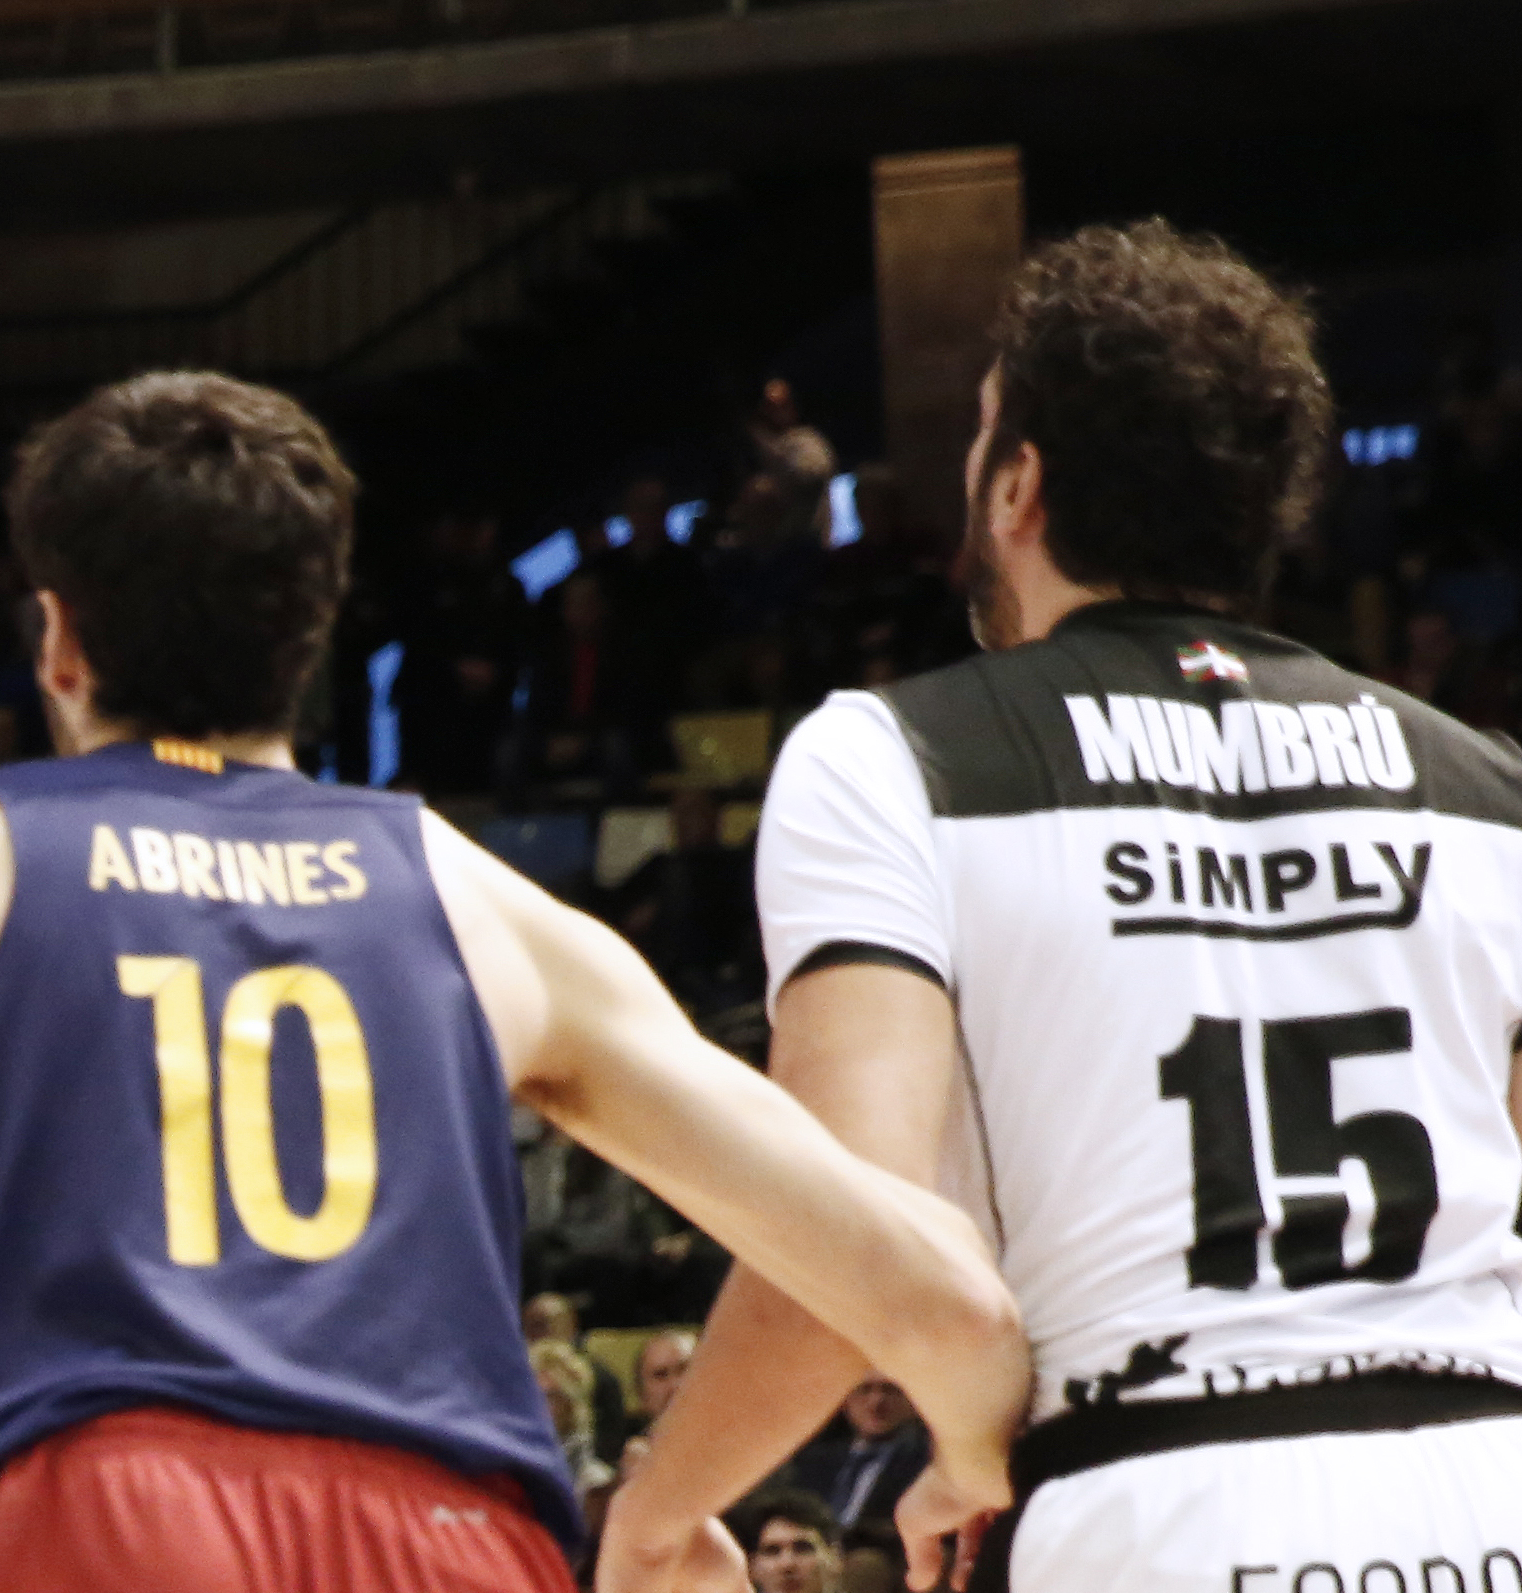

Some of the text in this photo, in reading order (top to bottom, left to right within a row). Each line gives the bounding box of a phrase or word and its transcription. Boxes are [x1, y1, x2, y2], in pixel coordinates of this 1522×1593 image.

[88, 823, 369, 907] ABRINES
[116, 954, 378, 1267] 10
[1158, 1007, 1439, 1290] 15
